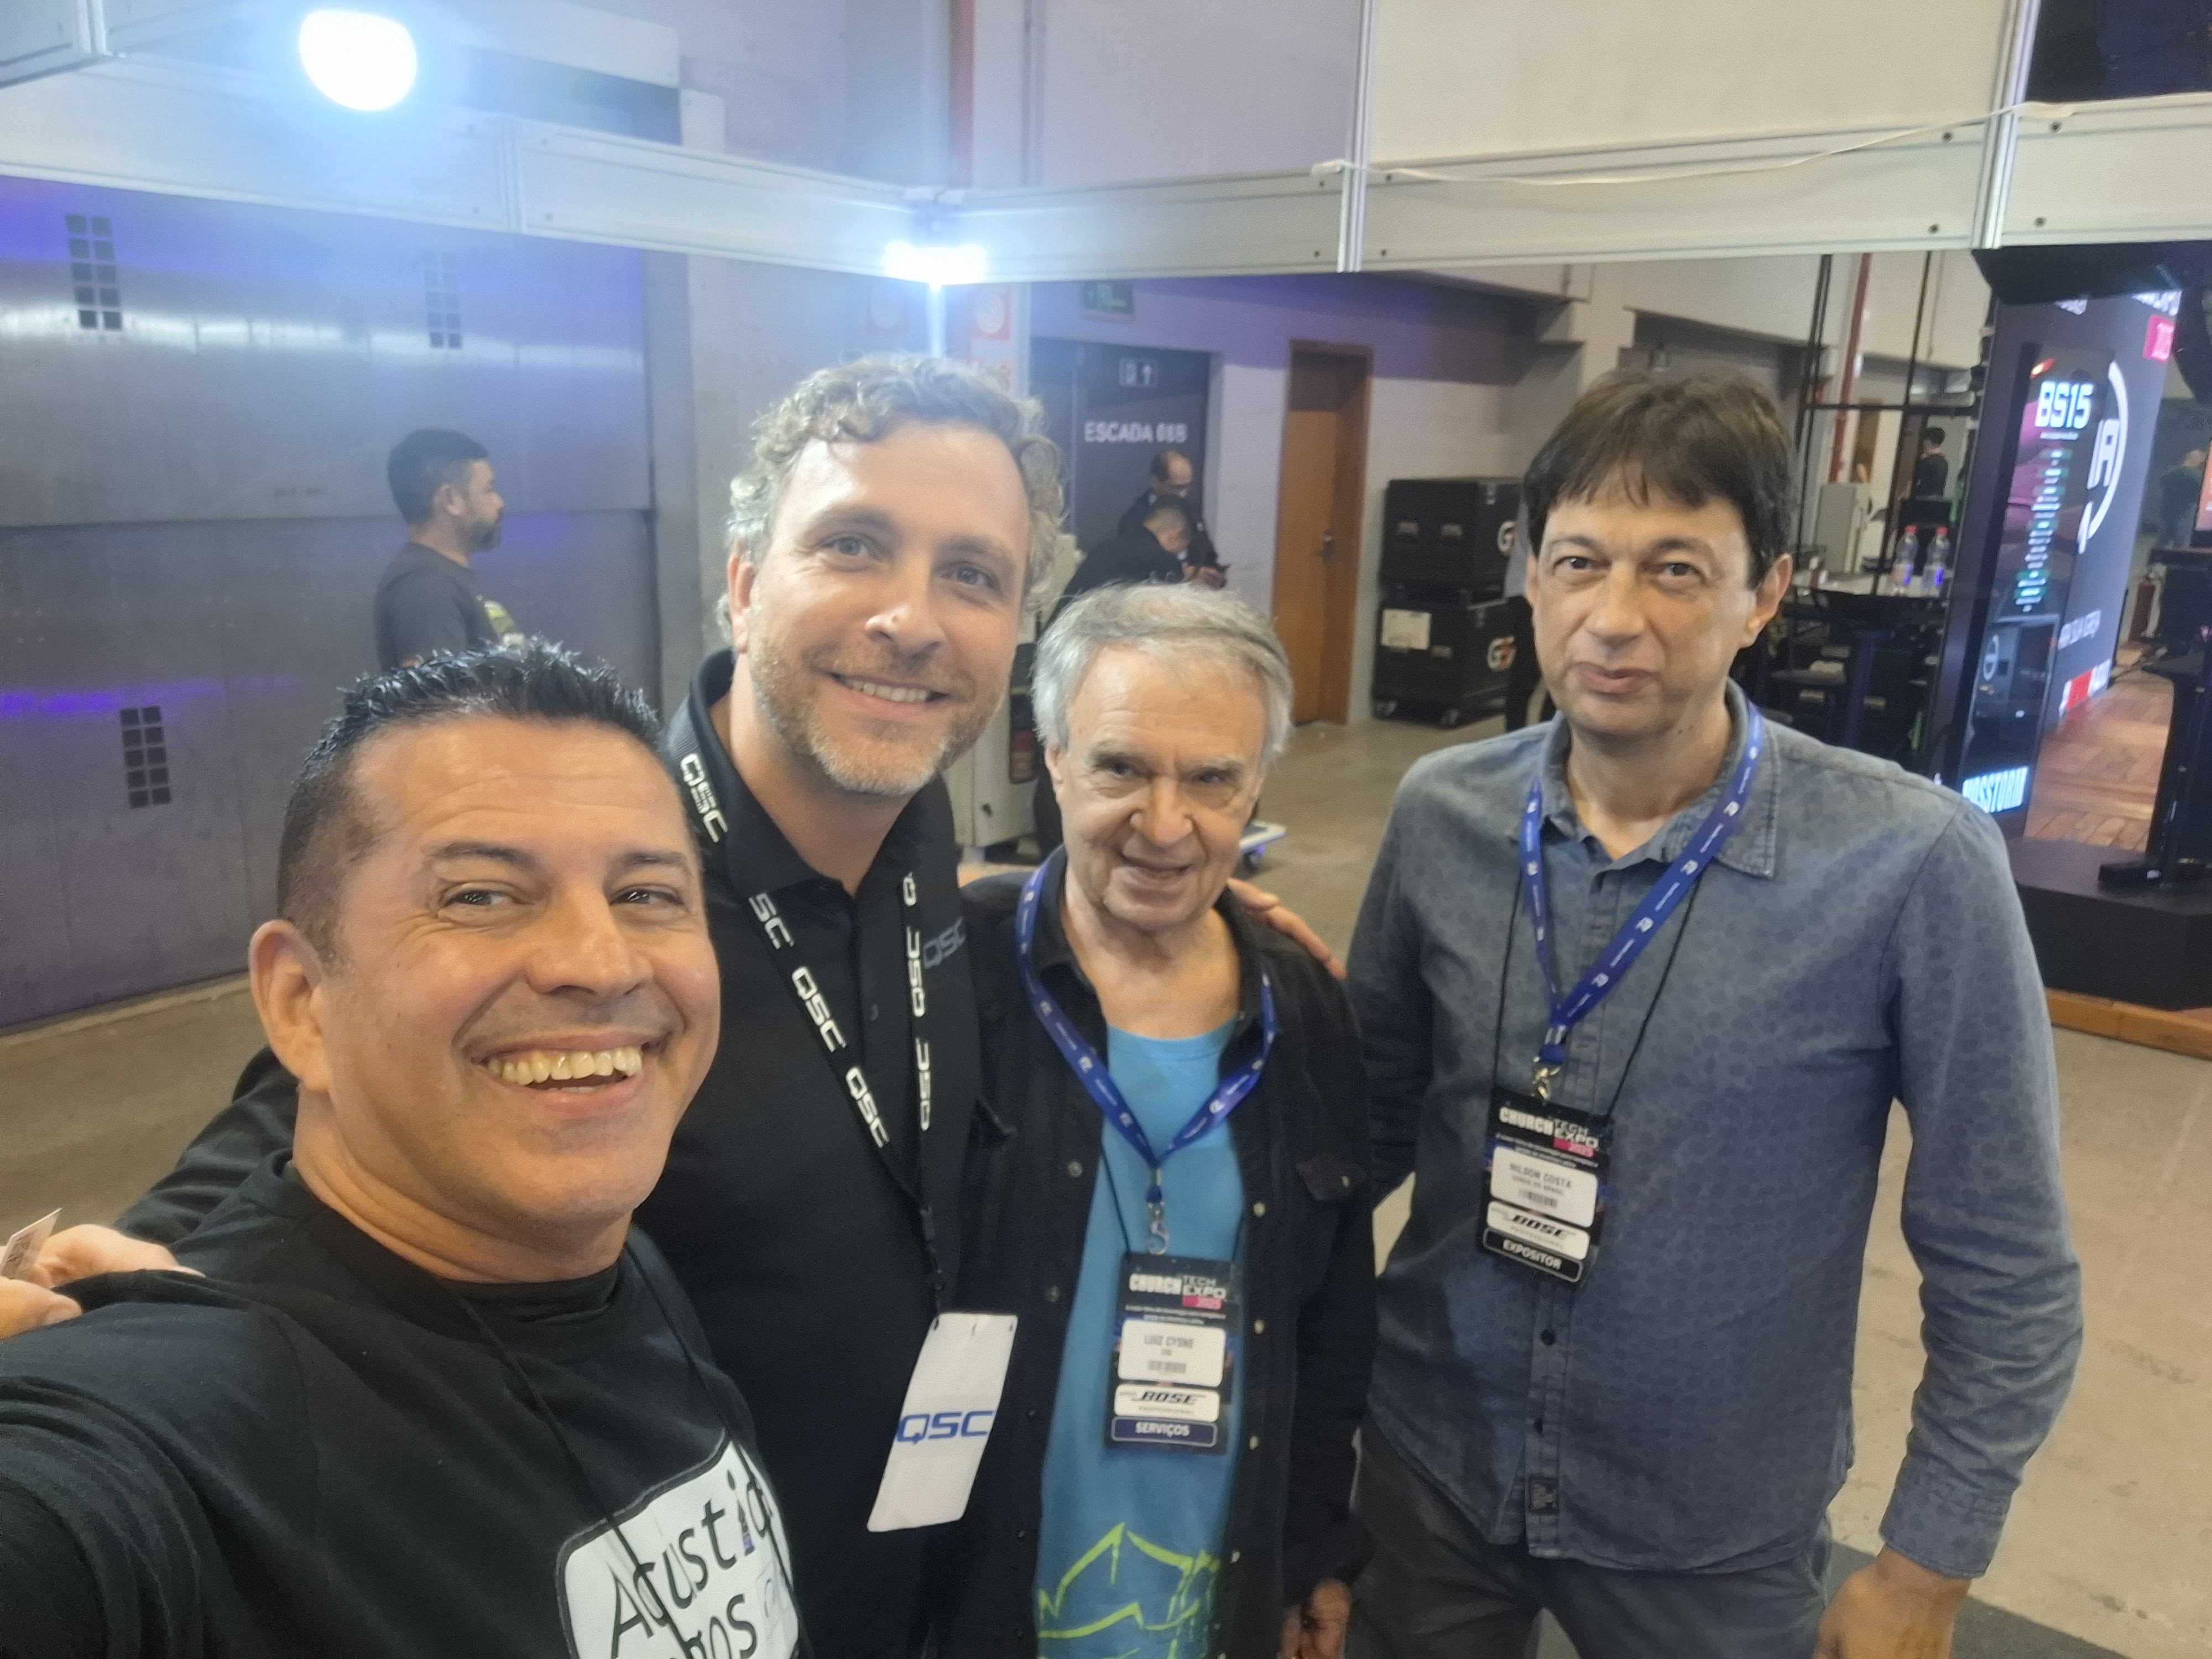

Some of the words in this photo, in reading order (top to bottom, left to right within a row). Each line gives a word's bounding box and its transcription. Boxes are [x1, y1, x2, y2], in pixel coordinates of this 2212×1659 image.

[1085, 421, 1154, 442] ESCADA
[2035, 381, 2094, 429] BS15
[680, 753, 728, 842] QSC
[748, 892, 795, 950] SC
[923, 917, 967, 969] QSC
[906, 926, 926, 1017] QSC
[792, 966, 848, 1053] QSC
[846, 1066, 890, 1149] QSC
[915, 1037, 931, 1131] QSC
[1503, 1239, 1562, 1270] EXPOSITOR
[1141, 1391, 1197, 1405] BOSE
[897, 1410, 994, 1444] QSC
